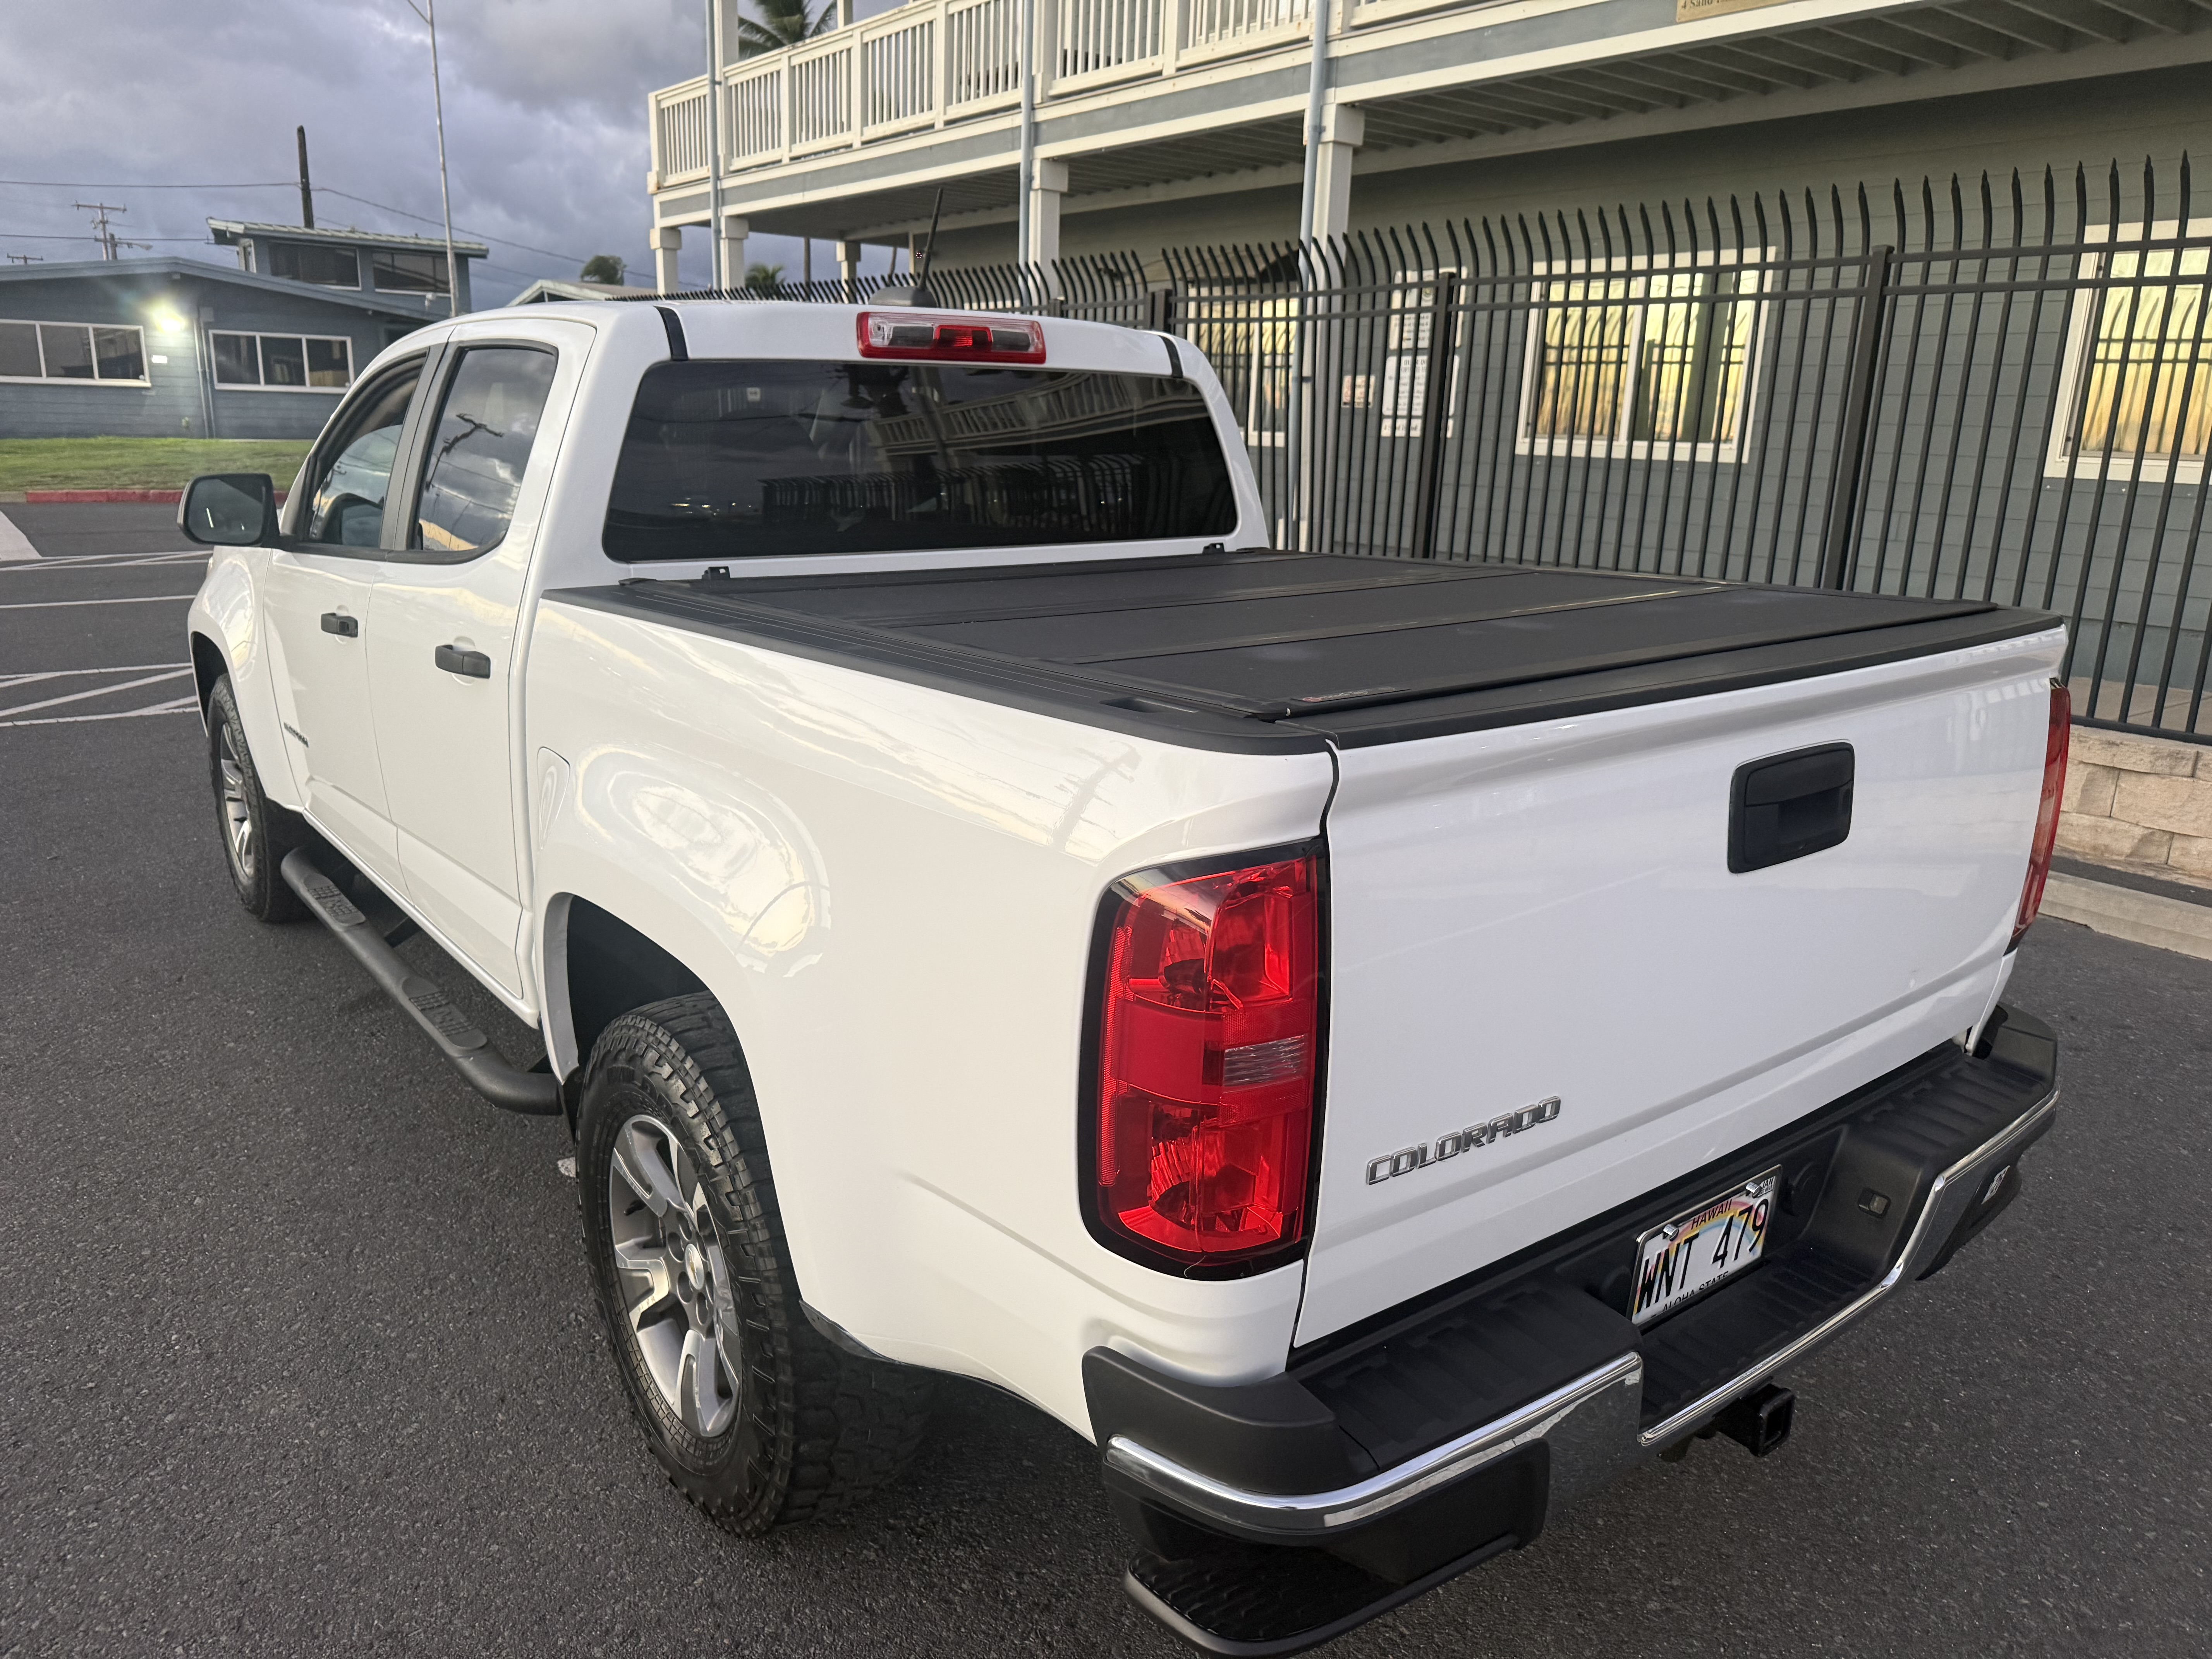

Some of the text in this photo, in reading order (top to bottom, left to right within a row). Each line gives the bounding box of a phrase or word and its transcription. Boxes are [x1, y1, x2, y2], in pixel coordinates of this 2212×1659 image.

[1366, 1096, 1561, 1185] COLORADO
[1634, 1198, 1769, 1314] WNT 479
[1691, 1199, 1733, 1230] HAWAII
